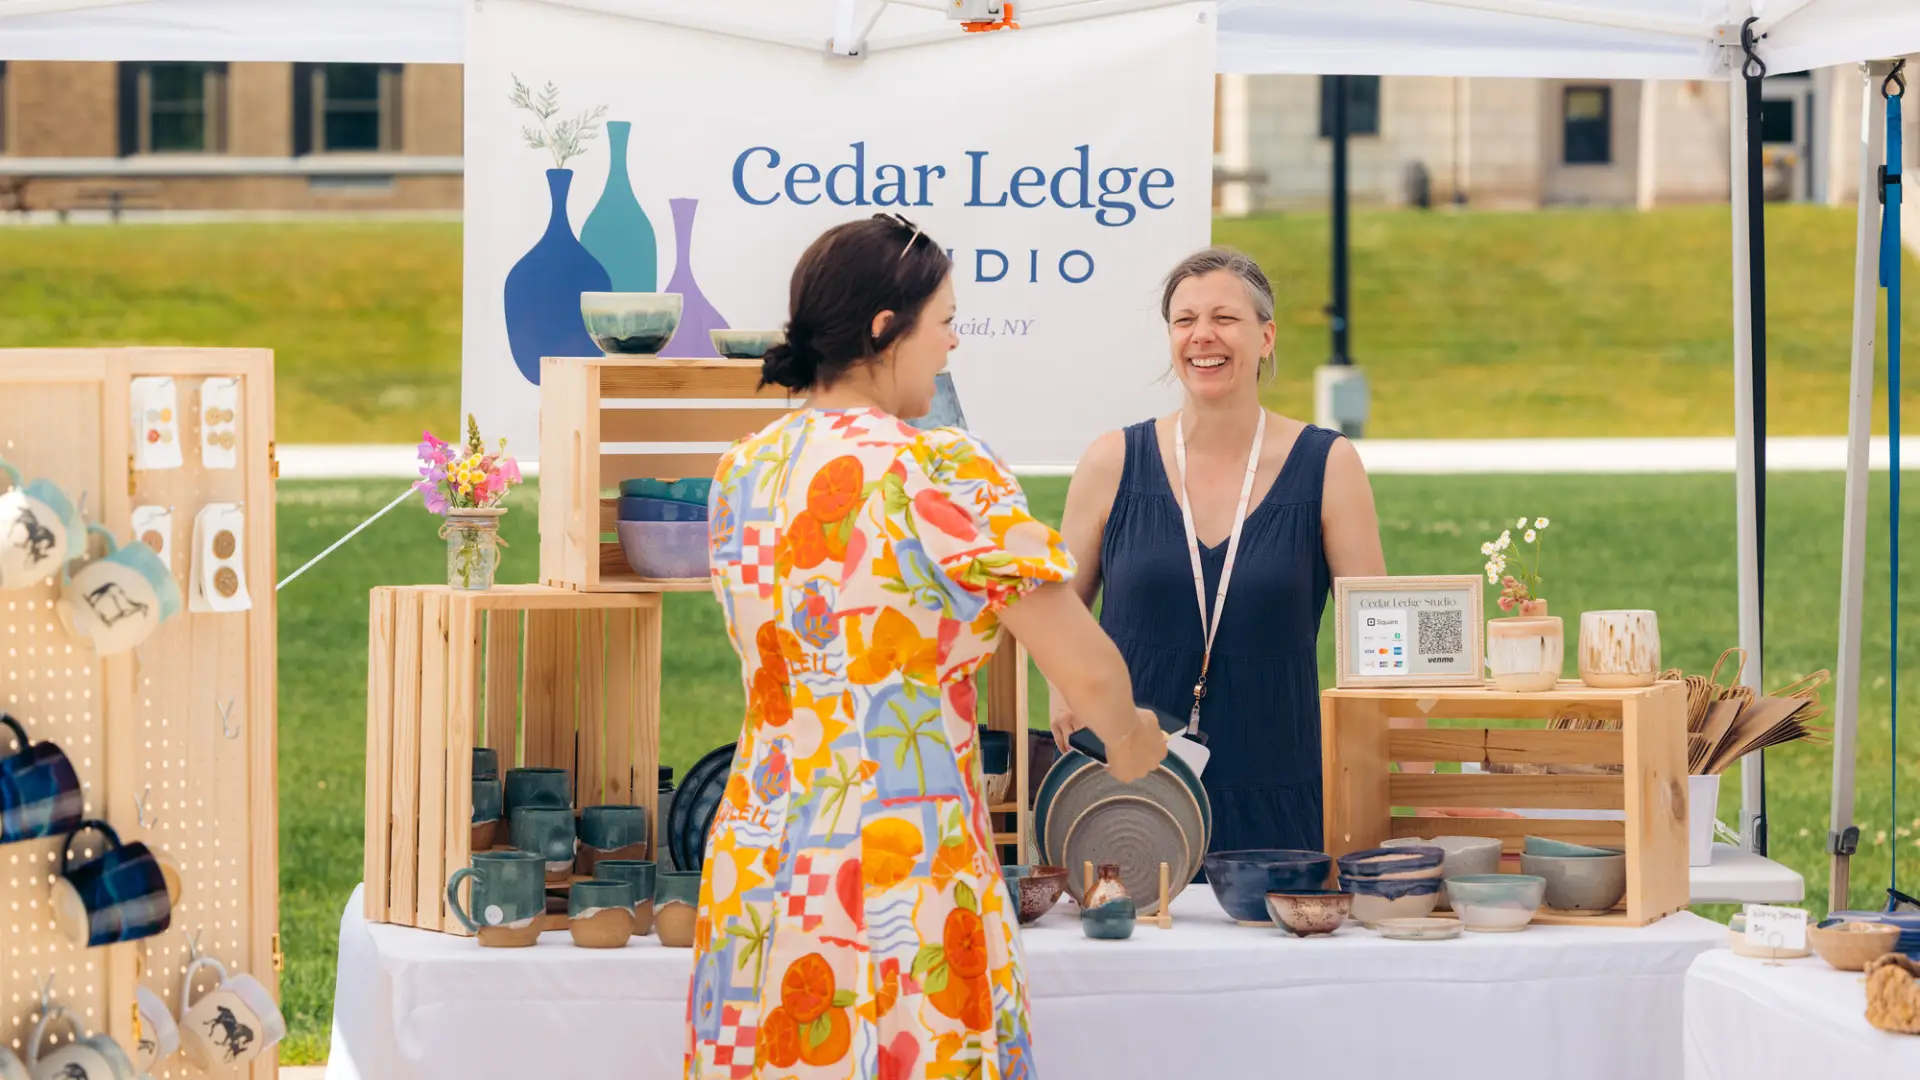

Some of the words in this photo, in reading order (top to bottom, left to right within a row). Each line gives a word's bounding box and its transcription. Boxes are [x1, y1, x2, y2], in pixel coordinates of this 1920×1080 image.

[732, 141, 945, 207] Cedar
[964, 144, 1175, 226] Ledge
[946, 248, 1095, 283] DIO
[1001, 319, 1035, 336] NY
[1360, 599, 1390, 608] Cedar
[1393, 597, 1421, 608] Ledge
